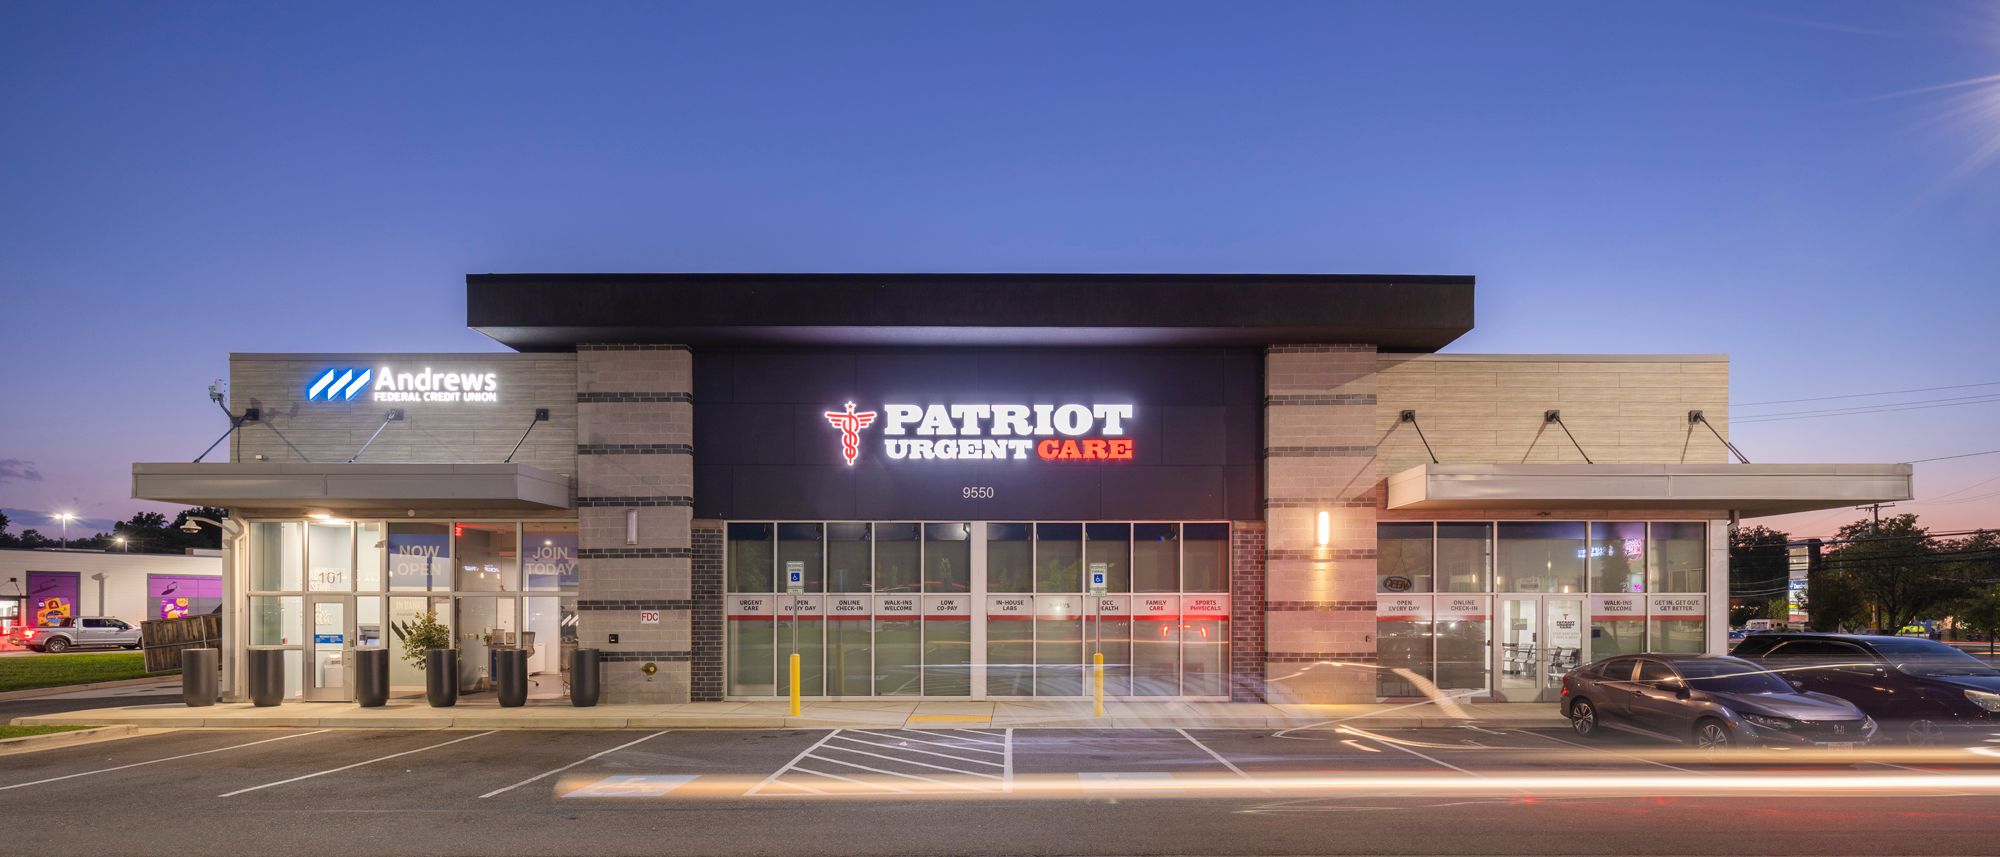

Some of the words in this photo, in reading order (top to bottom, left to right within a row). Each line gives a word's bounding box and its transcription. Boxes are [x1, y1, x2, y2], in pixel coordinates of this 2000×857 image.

[375, 366, 497, 391] Andrews
[374, 391, 420, 402] FEDERAL
[423, 391, 460, 402] CREDIT
[463, 391, 497, 402] UNION
[884, 404, 1133, 436] PATRIOT
[884, 439, 1033, 460] URGENT
[1037, 439, 1133, 460] CARE
[962, 486, 995, 500] 9550
[399, 545, 440, 557] NOW
[532, 546, 568, 560] JOIN
[397, 562, 441, 577] OPEN
[525, 562, 576, 576] TODAY
[318, 571, 343, 585] 101
[641, 612, 659, 622] FDC
